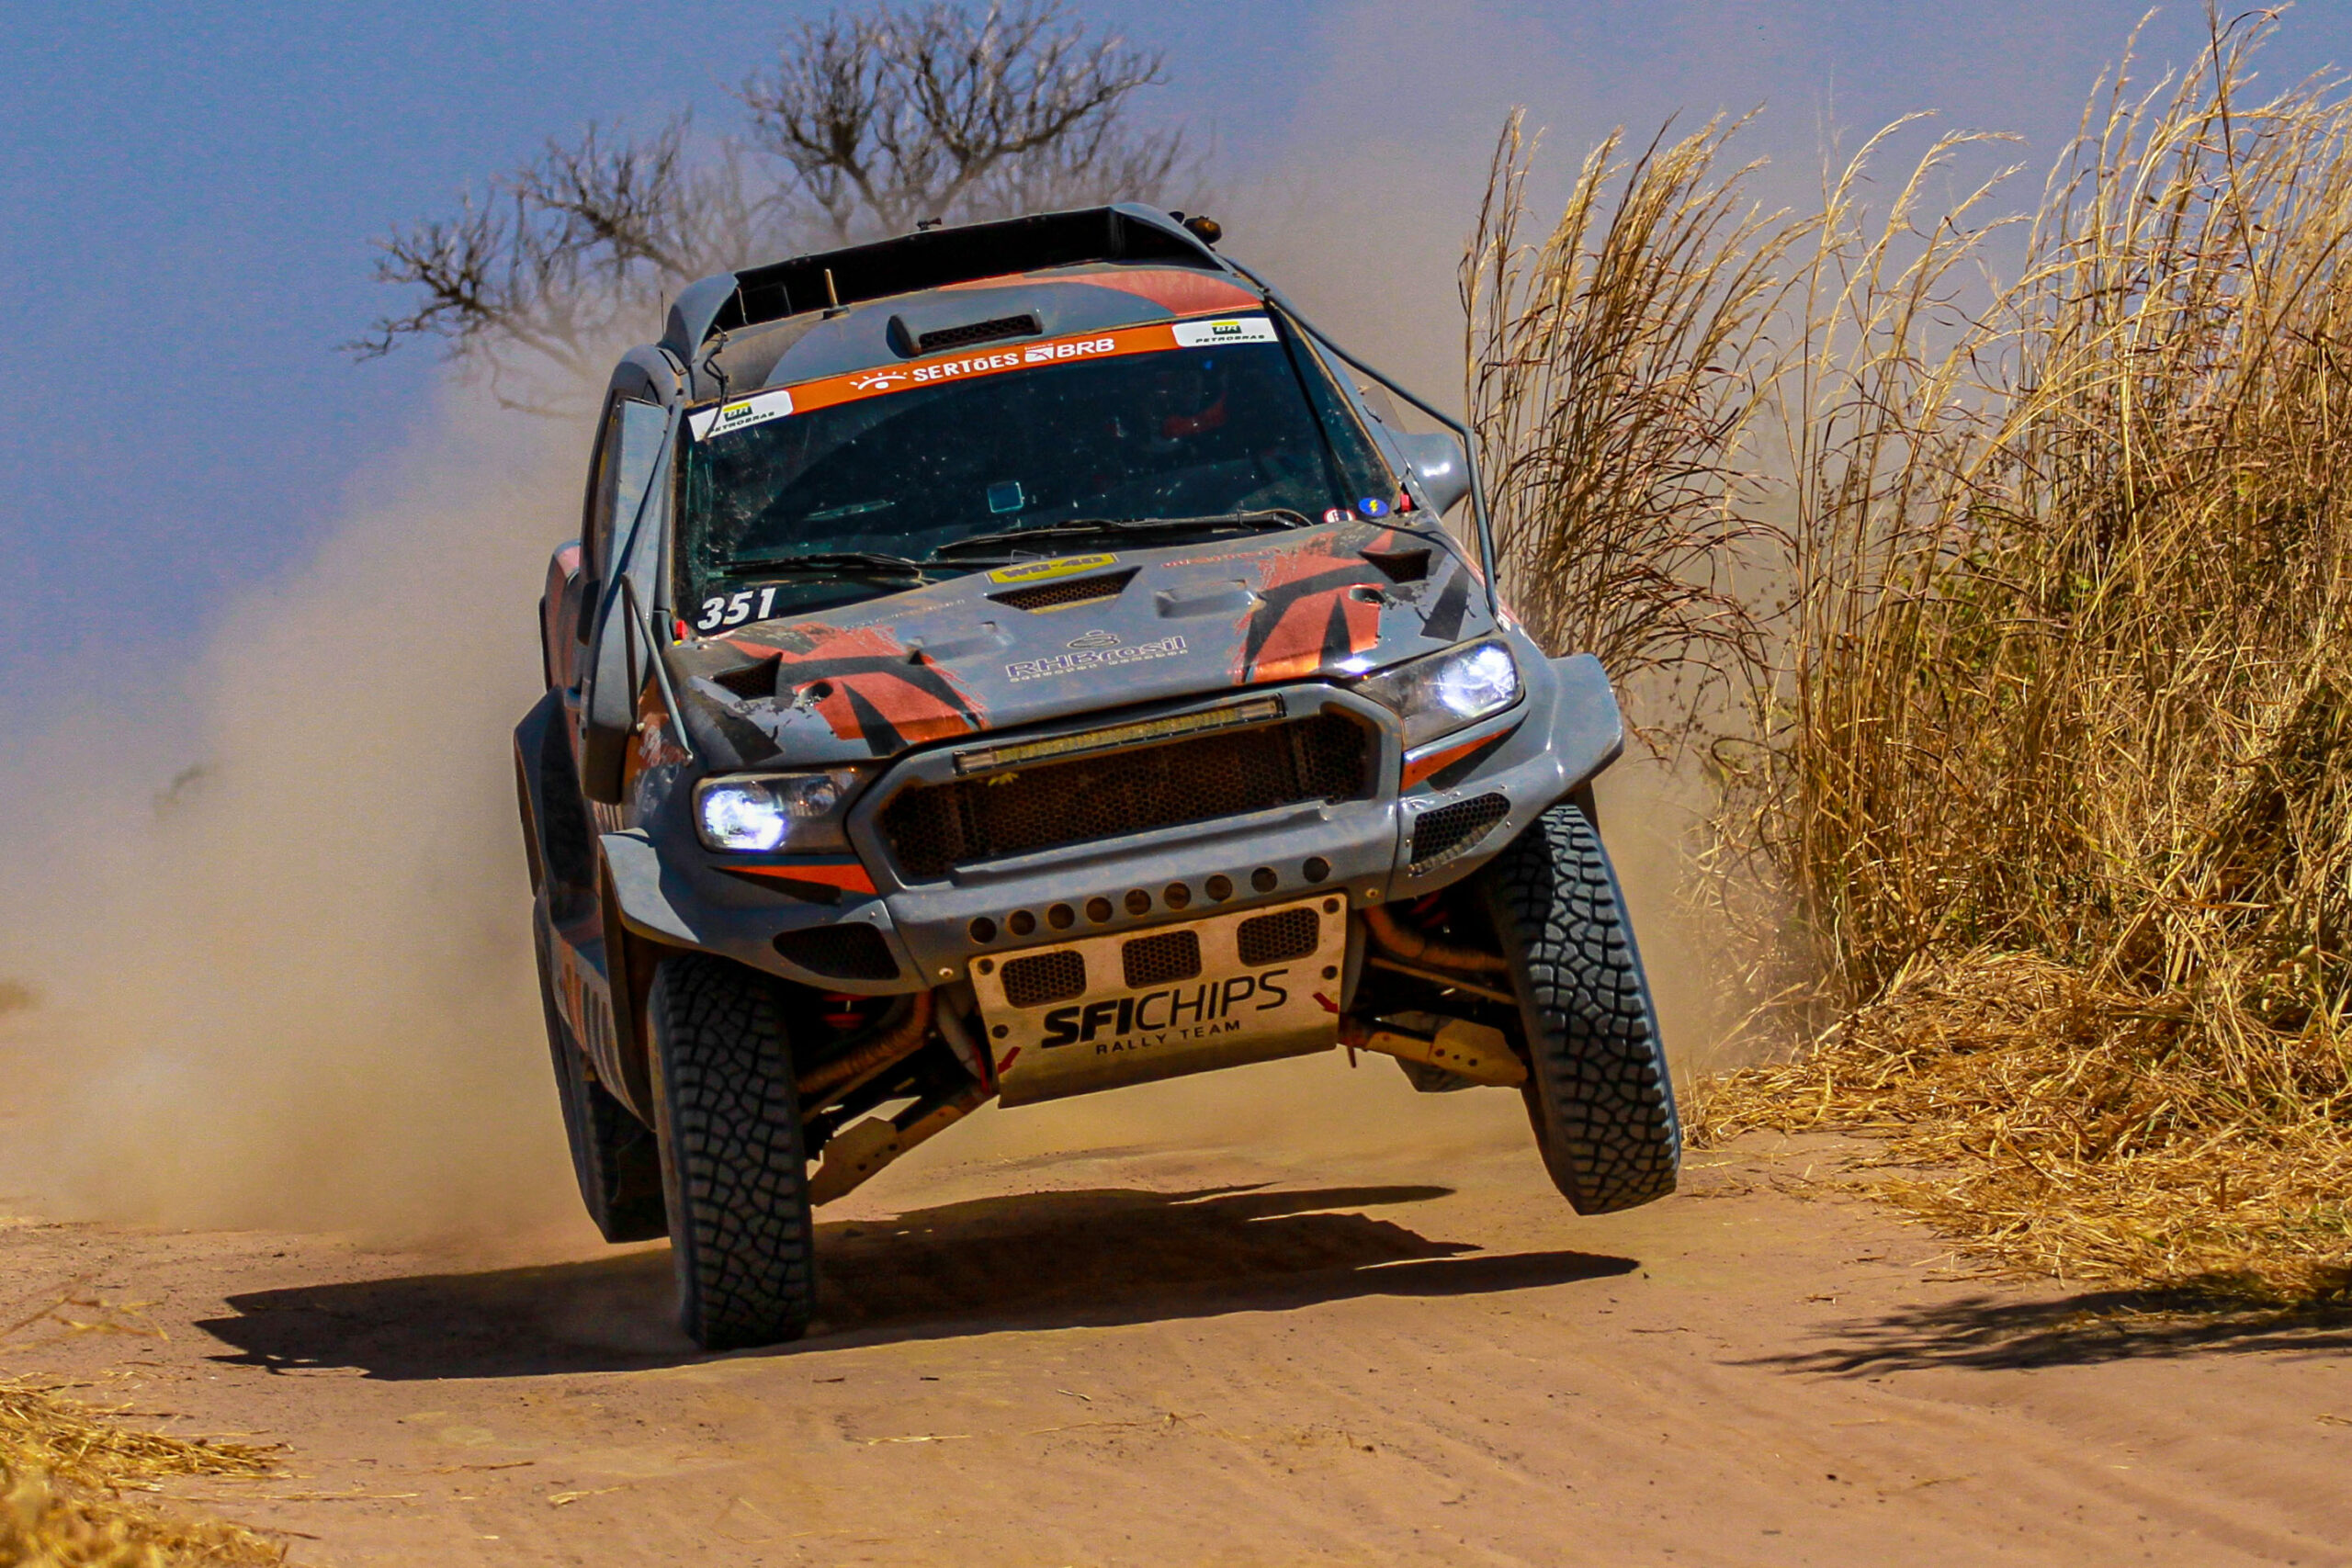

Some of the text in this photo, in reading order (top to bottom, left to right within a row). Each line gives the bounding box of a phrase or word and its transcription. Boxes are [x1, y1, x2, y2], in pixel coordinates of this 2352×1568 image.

[912, 337, 1115, 382] SERTÕES BRB
[1195, 334, 1265, 343] PETROBRAS
[696, 587, 776, 630] 351
[1005, 635, 1186, 678] RHBrasil
[1095, 1020, 1240, 1055] RALLY TEAM
